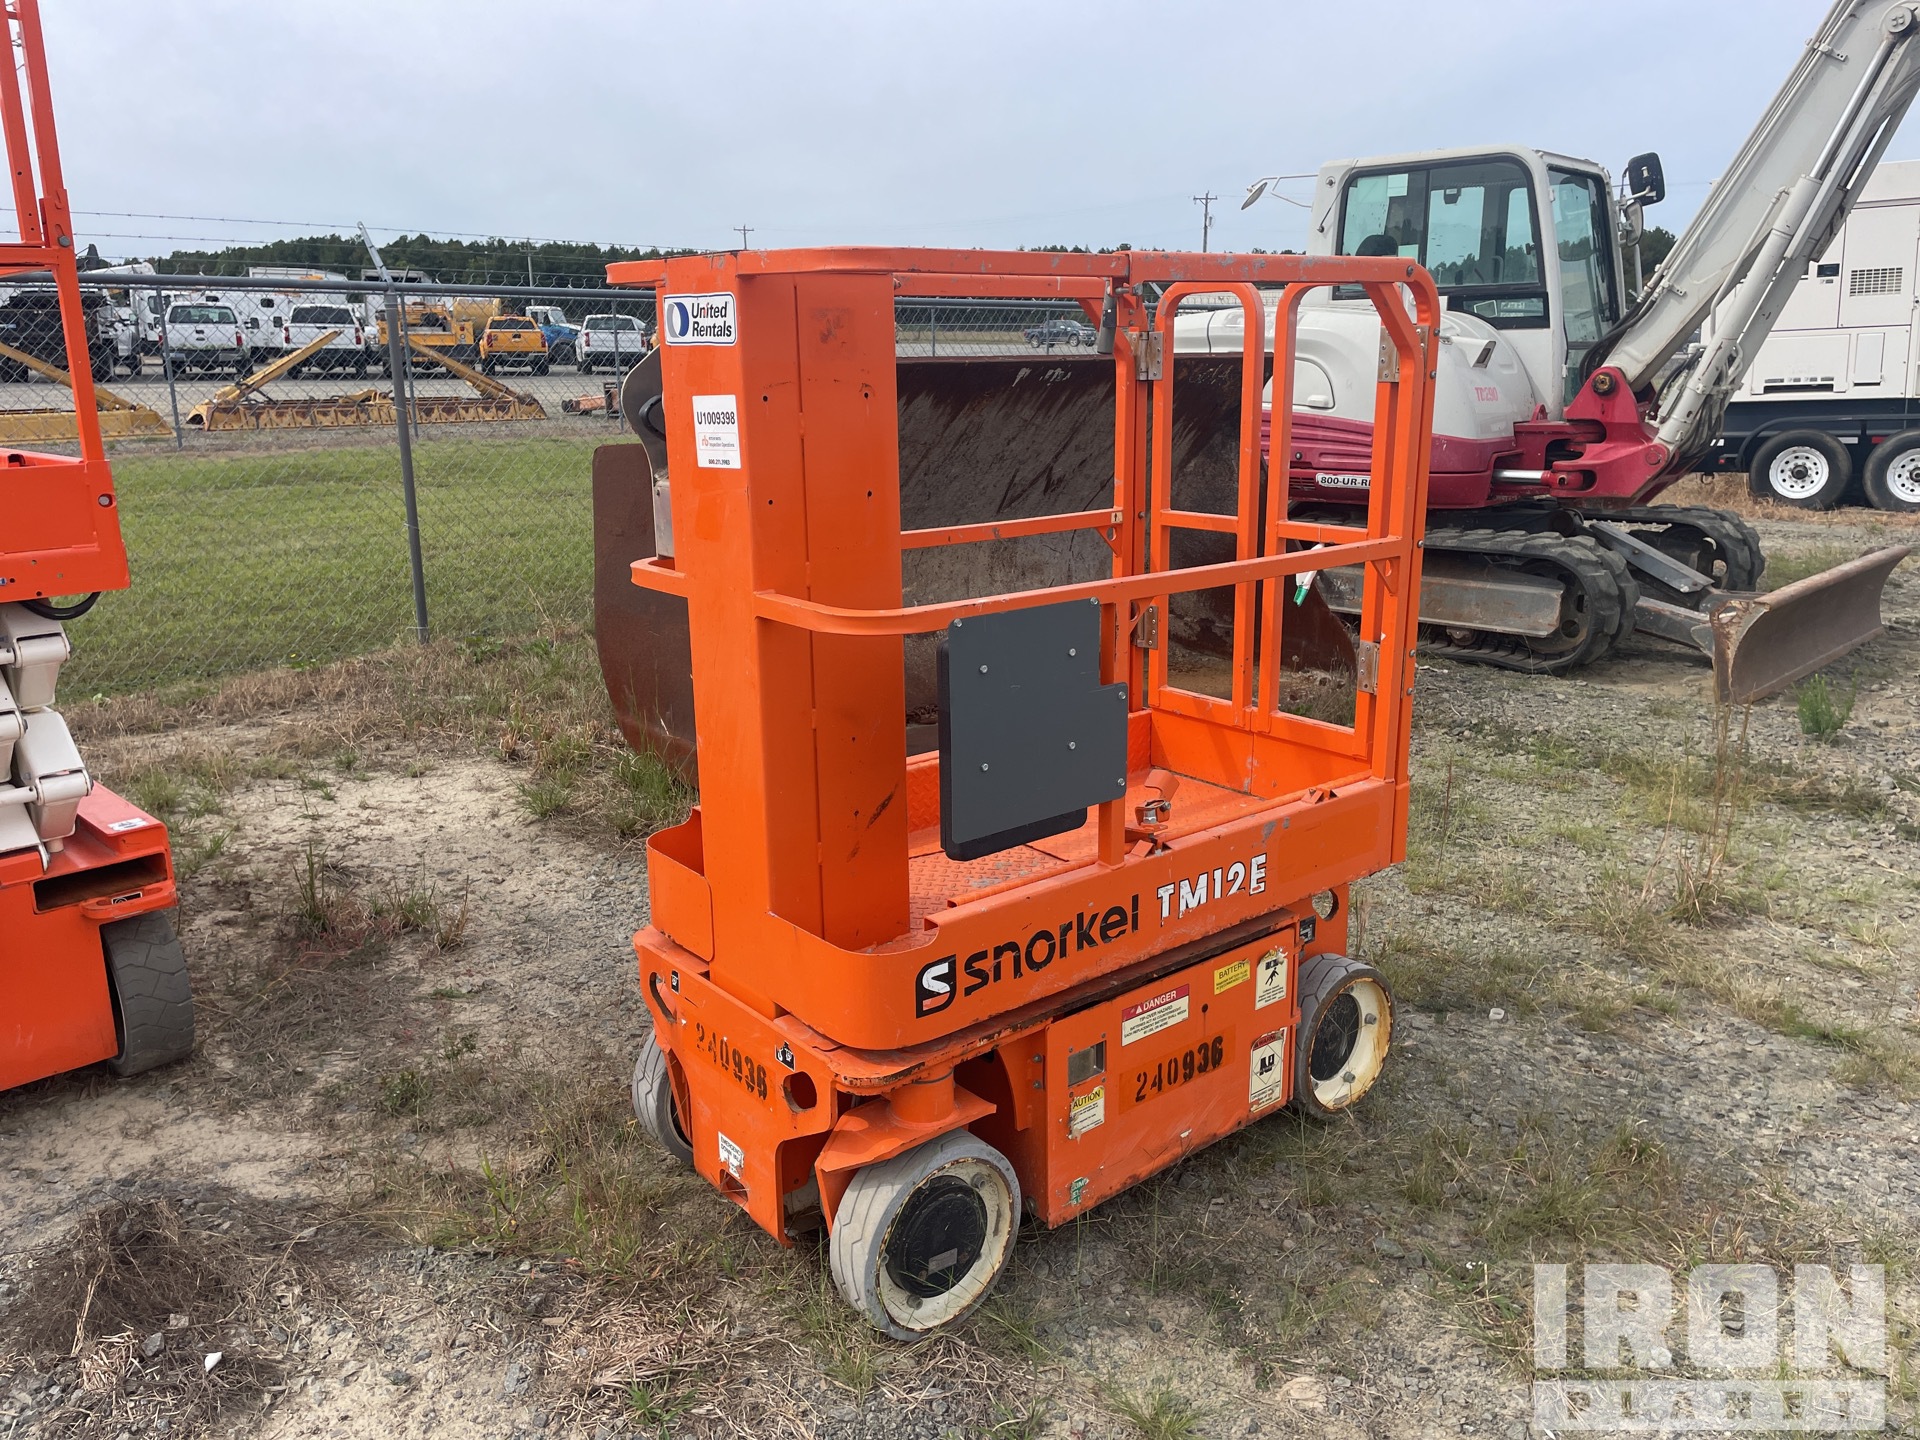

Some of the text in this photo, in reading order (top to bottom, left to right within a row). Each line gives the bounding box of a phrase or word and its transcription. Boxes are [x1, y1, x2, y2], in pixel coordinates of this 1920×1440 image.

[691, 301, 728, 319] United
[692, 320, 732, 337] Rentals
[696, 411, 736, 425] U1009398
[964, 894, 1140, 996] snorkel
[1156, 853, 1267, 927] TM12E
[1218, 962, 1246, 979] BATTERY
[1143, 990, 1177, 1011] DANGER
[1157, 1005, 1173, 1014] HAZARD
[696, 1022, 768, 1101] 240936
[1135, 1035, 1223, 1102] 240936
[1072, 1089, 1101, 1109] AUTION
